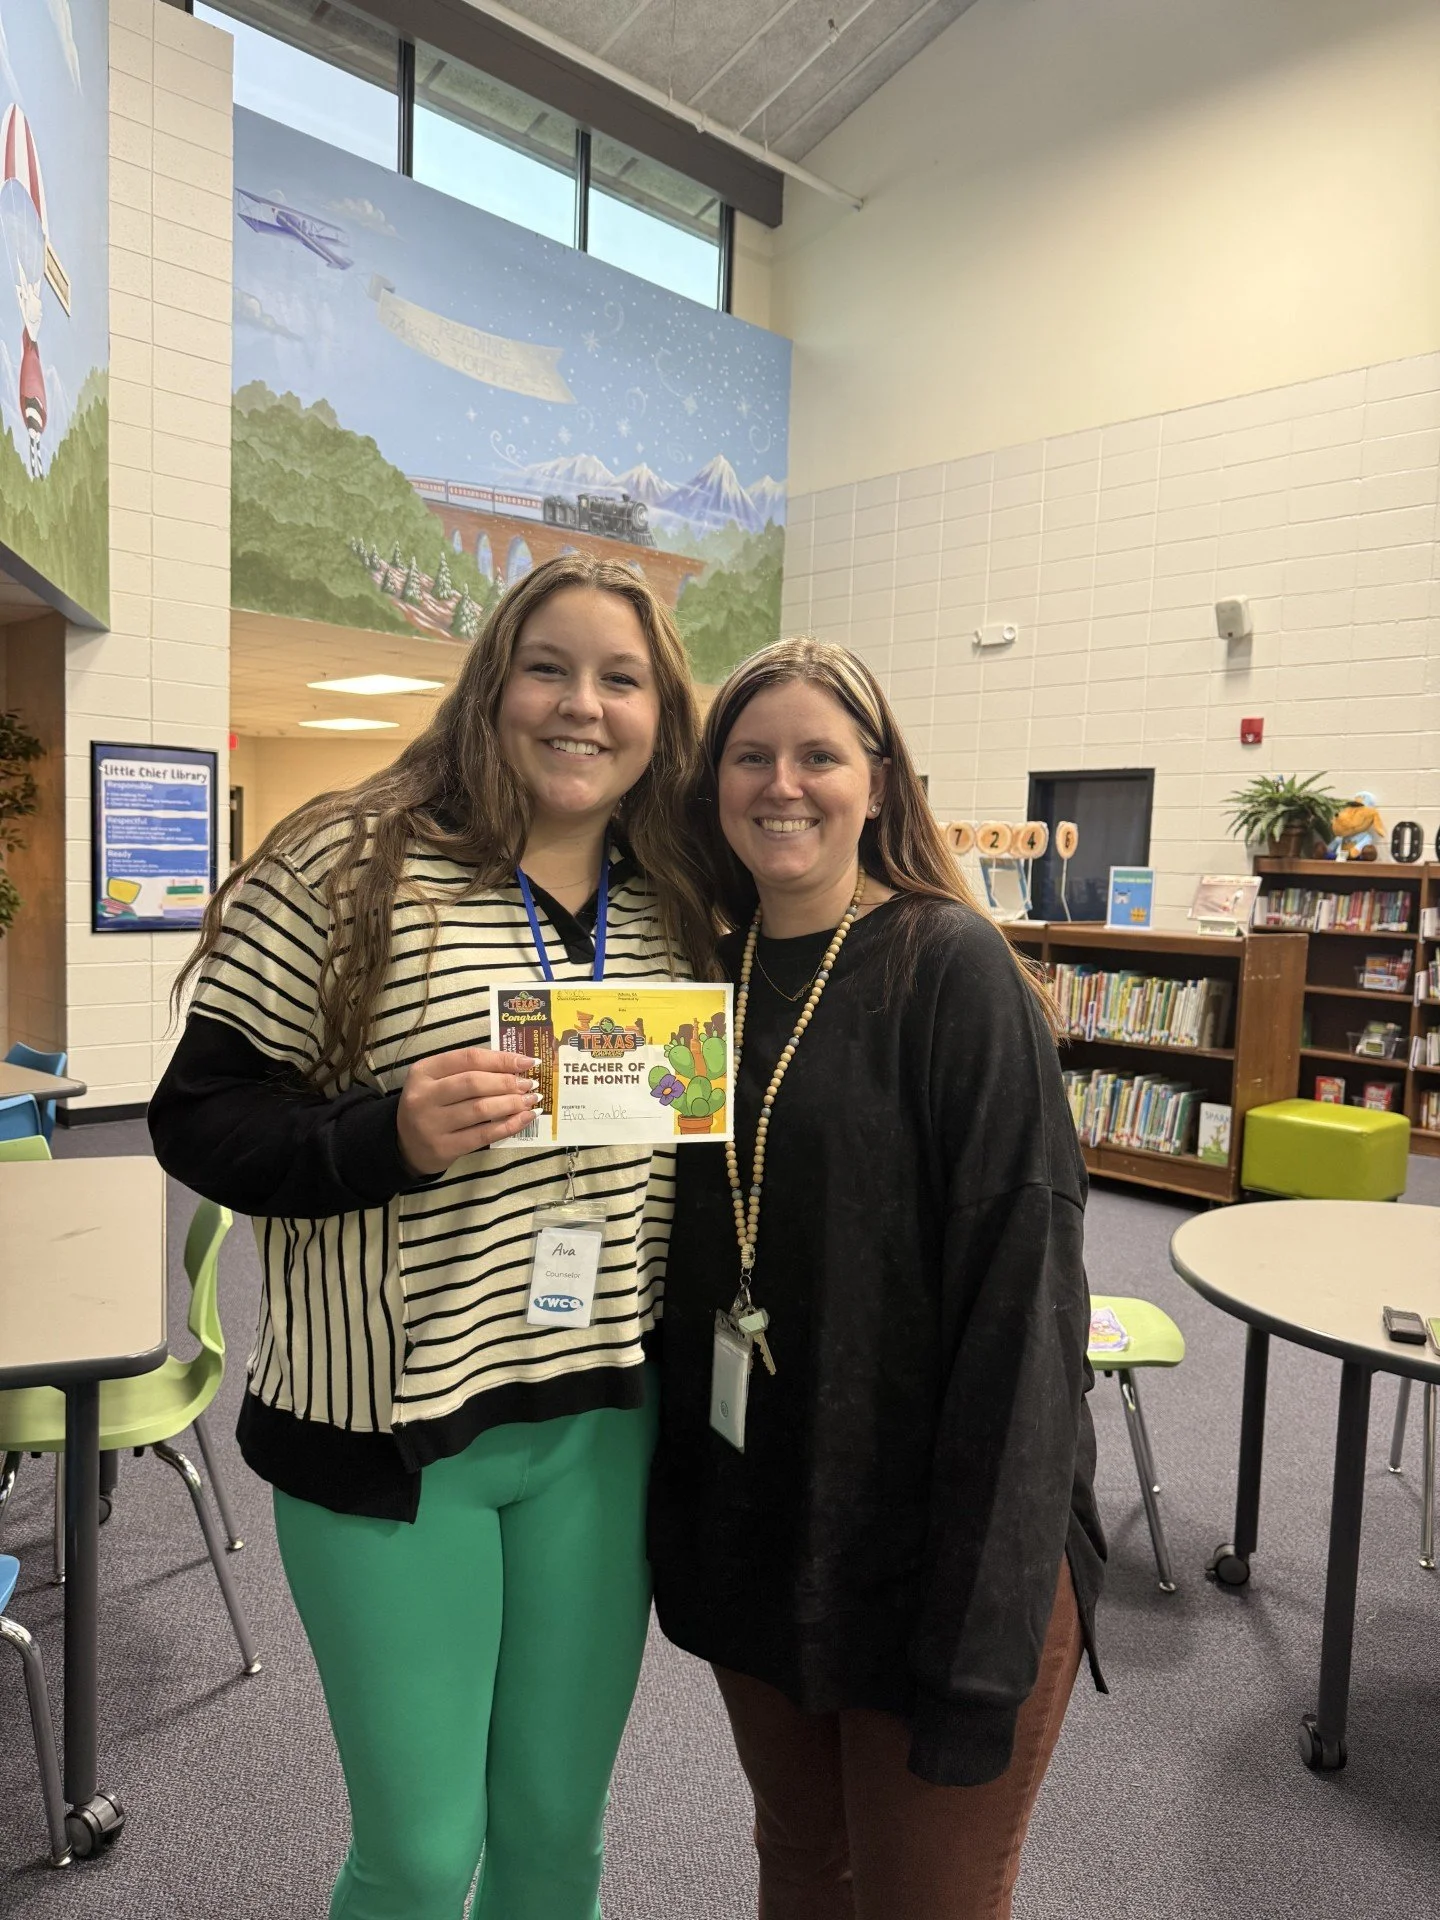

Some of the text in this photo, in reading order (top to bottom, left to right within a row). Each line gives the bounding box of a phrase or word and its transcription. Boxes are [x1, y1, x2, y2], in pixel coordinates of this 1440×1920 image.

[389, 311, 441, 357] TAKES
[104, 764, 208, 783] Little Chief Library
[989, 831, 1000, 849] 2
[1027, 831, 1037, 850] 4
[107, 850, 132, 860] Ready
[511, 1000, 540, 1008] TEXAS
[501, 1012, 547, 1024] Congrats
[580, 1034, 635, 1049] TEXAS
[563, 1062, 645, 1073] TEACHER OF
[564, 1074, 640, 1085] THE MONTH
[552, 1242, 577, 1256] Ava
[545, 1270, 581, 1279] Counselor
